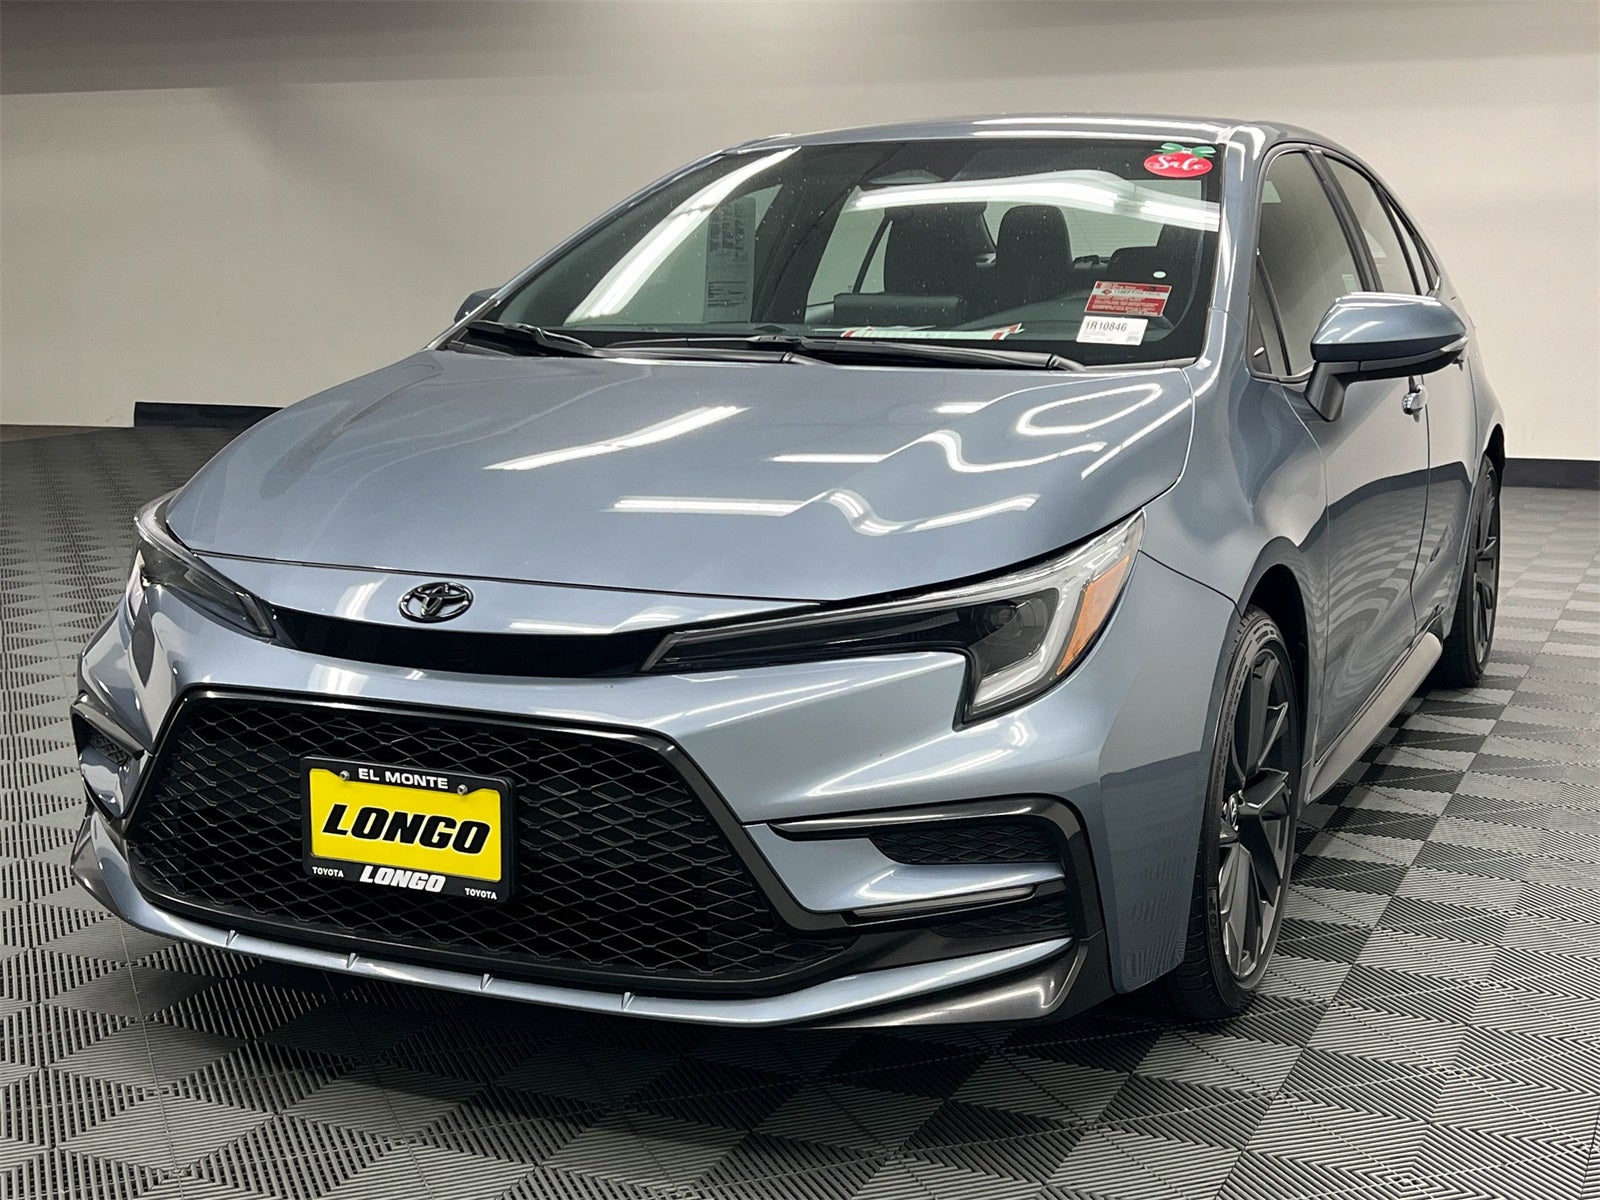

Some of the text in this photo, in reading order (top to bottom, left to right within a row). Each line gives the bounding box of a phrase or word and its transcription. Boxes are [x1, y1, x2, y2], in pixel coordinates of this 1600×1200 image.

[1147, 155, 1206, 171] Sale
[1085, 321, 1128, 332] 1R10846
[358, 768, 449, 790] EL MONTE
[322, 803, 491, 855] LONGO
[312, 866, 344, 878] TOYOTA
[359, 865, 446, 893] LONGO
[464, 887, 497, 900] TOYOTA
